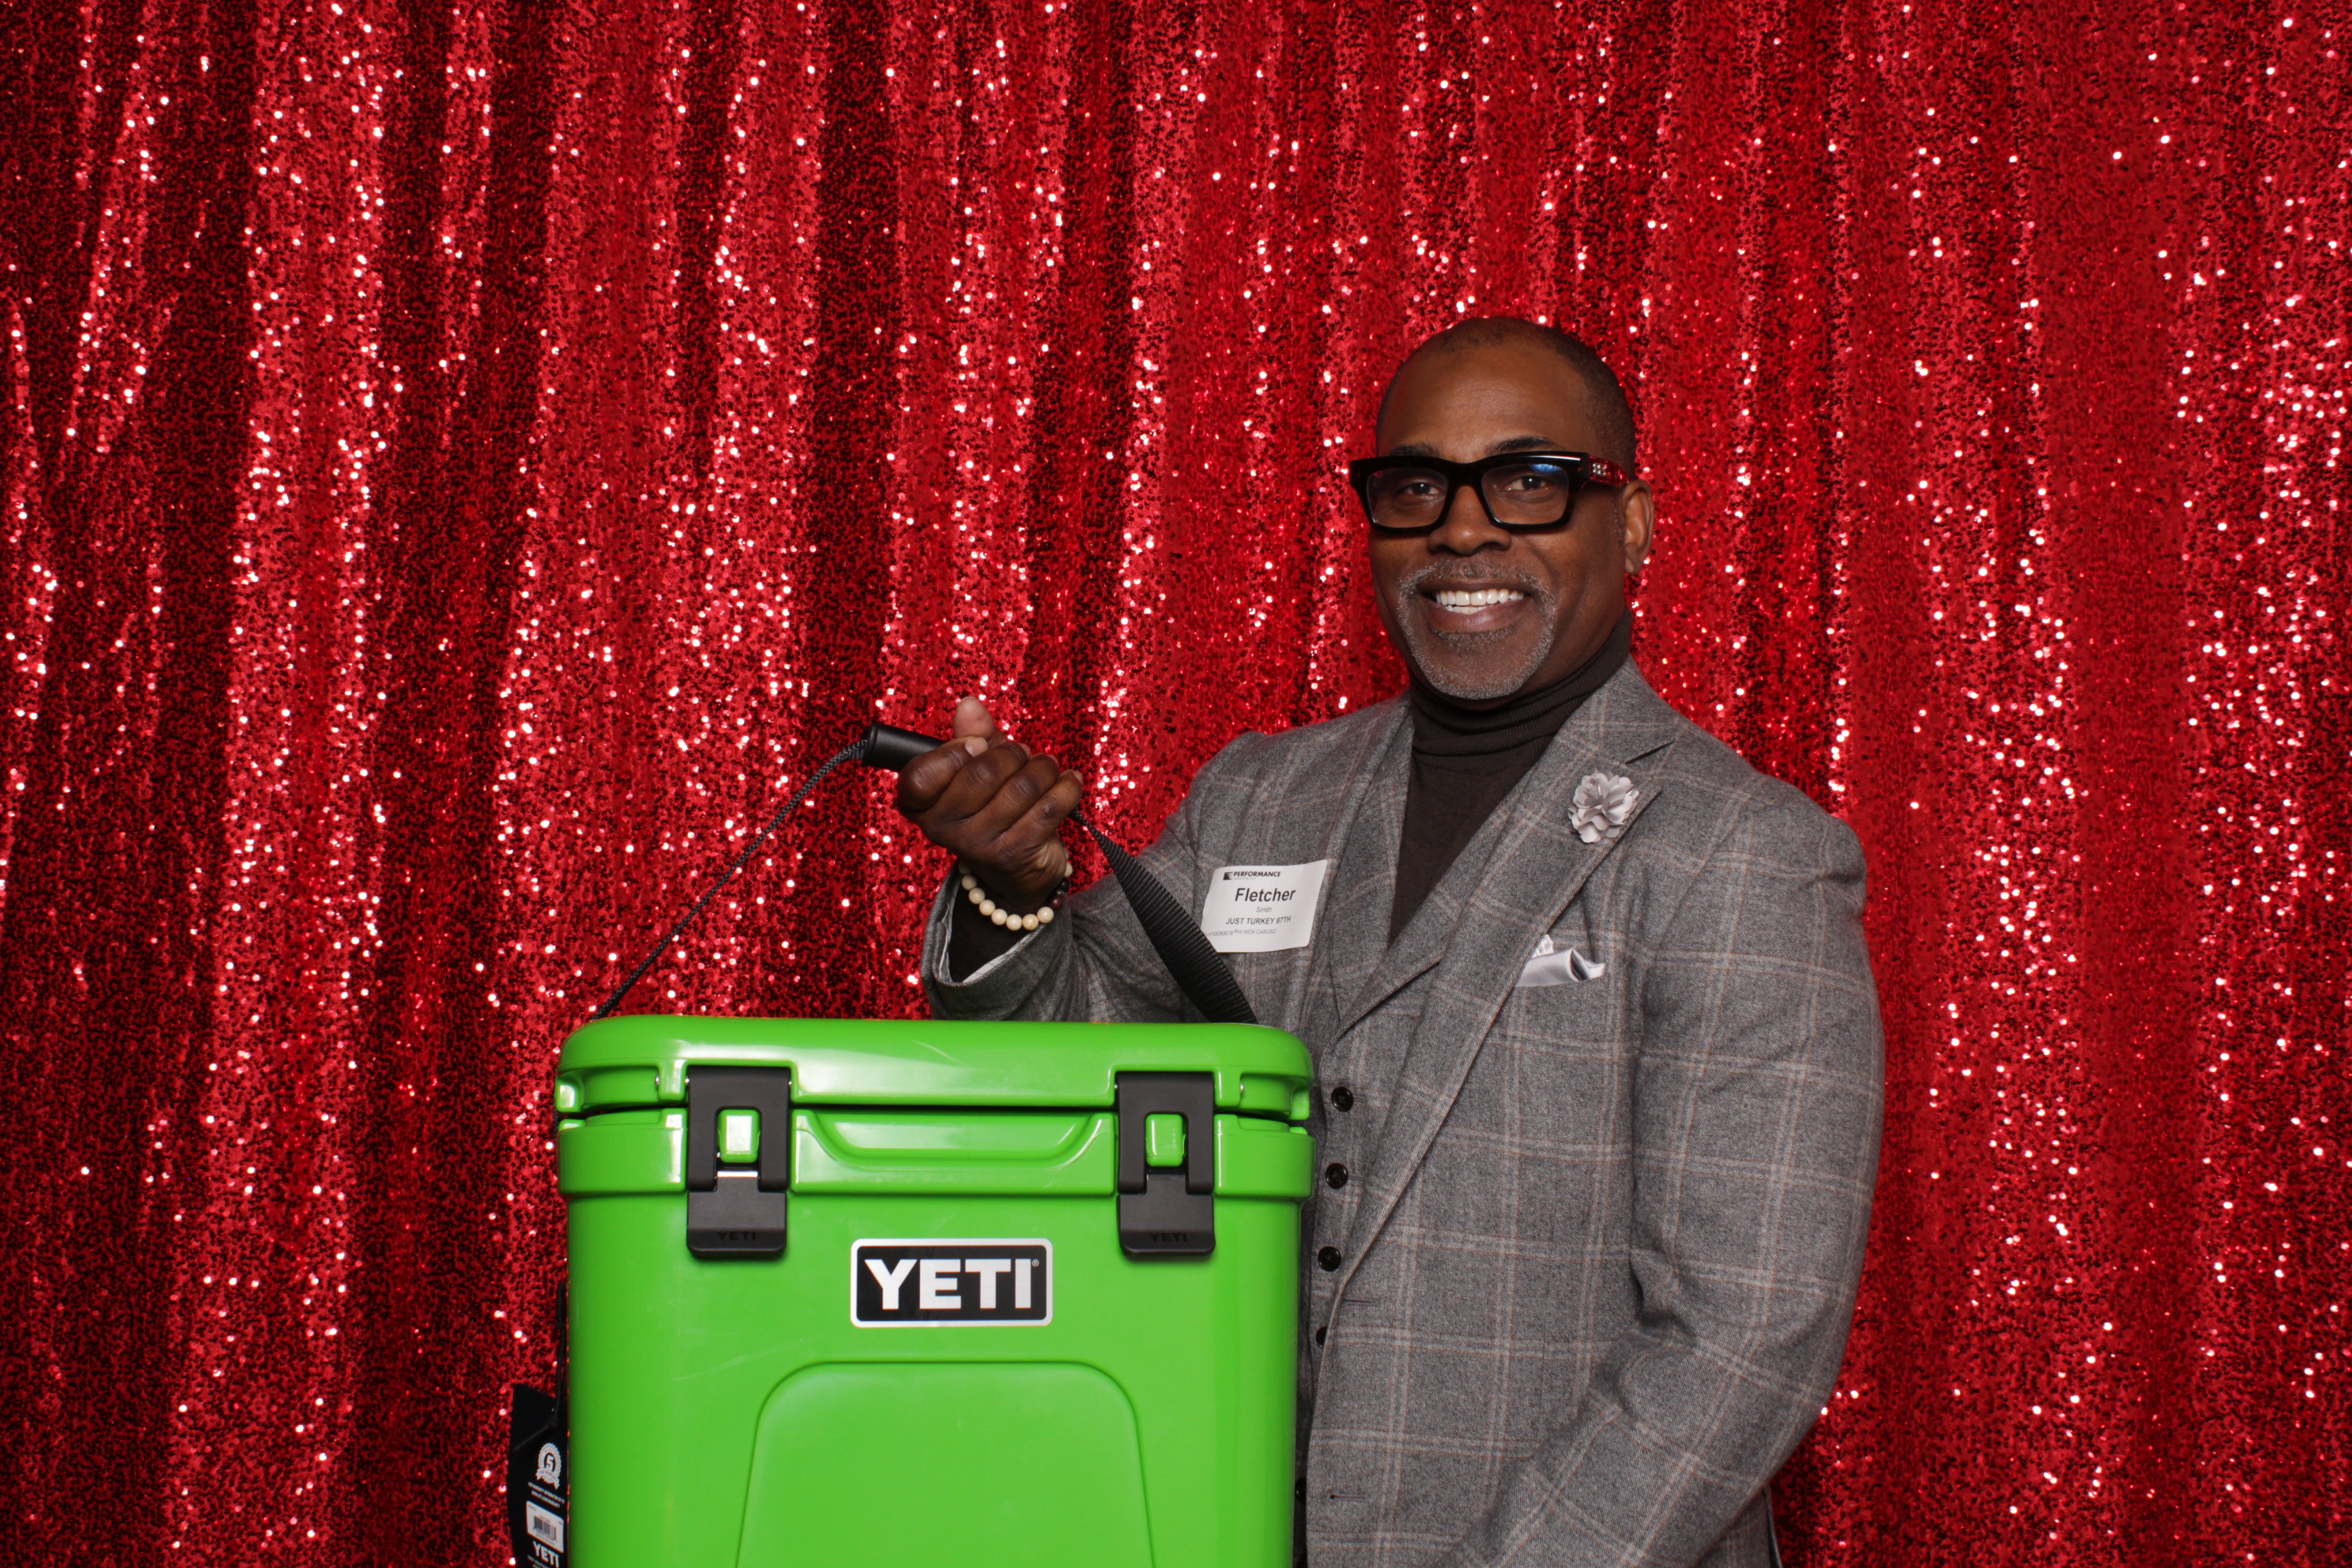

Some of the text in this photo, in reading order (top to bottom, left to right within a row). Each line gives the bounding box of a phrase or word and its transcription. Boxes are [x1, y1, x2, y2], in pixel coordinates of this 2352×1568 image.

[1235, 887, 1296, 902] Fletcher
[1276, 916, 1291, 924] 87TH
[717, 1230, 757, 1241] YETI
[1149, 1232, 1188, 1242] YETI
[546, 1454, 555, 1471] 5
[533, 1540, 559, 1568] YETI
